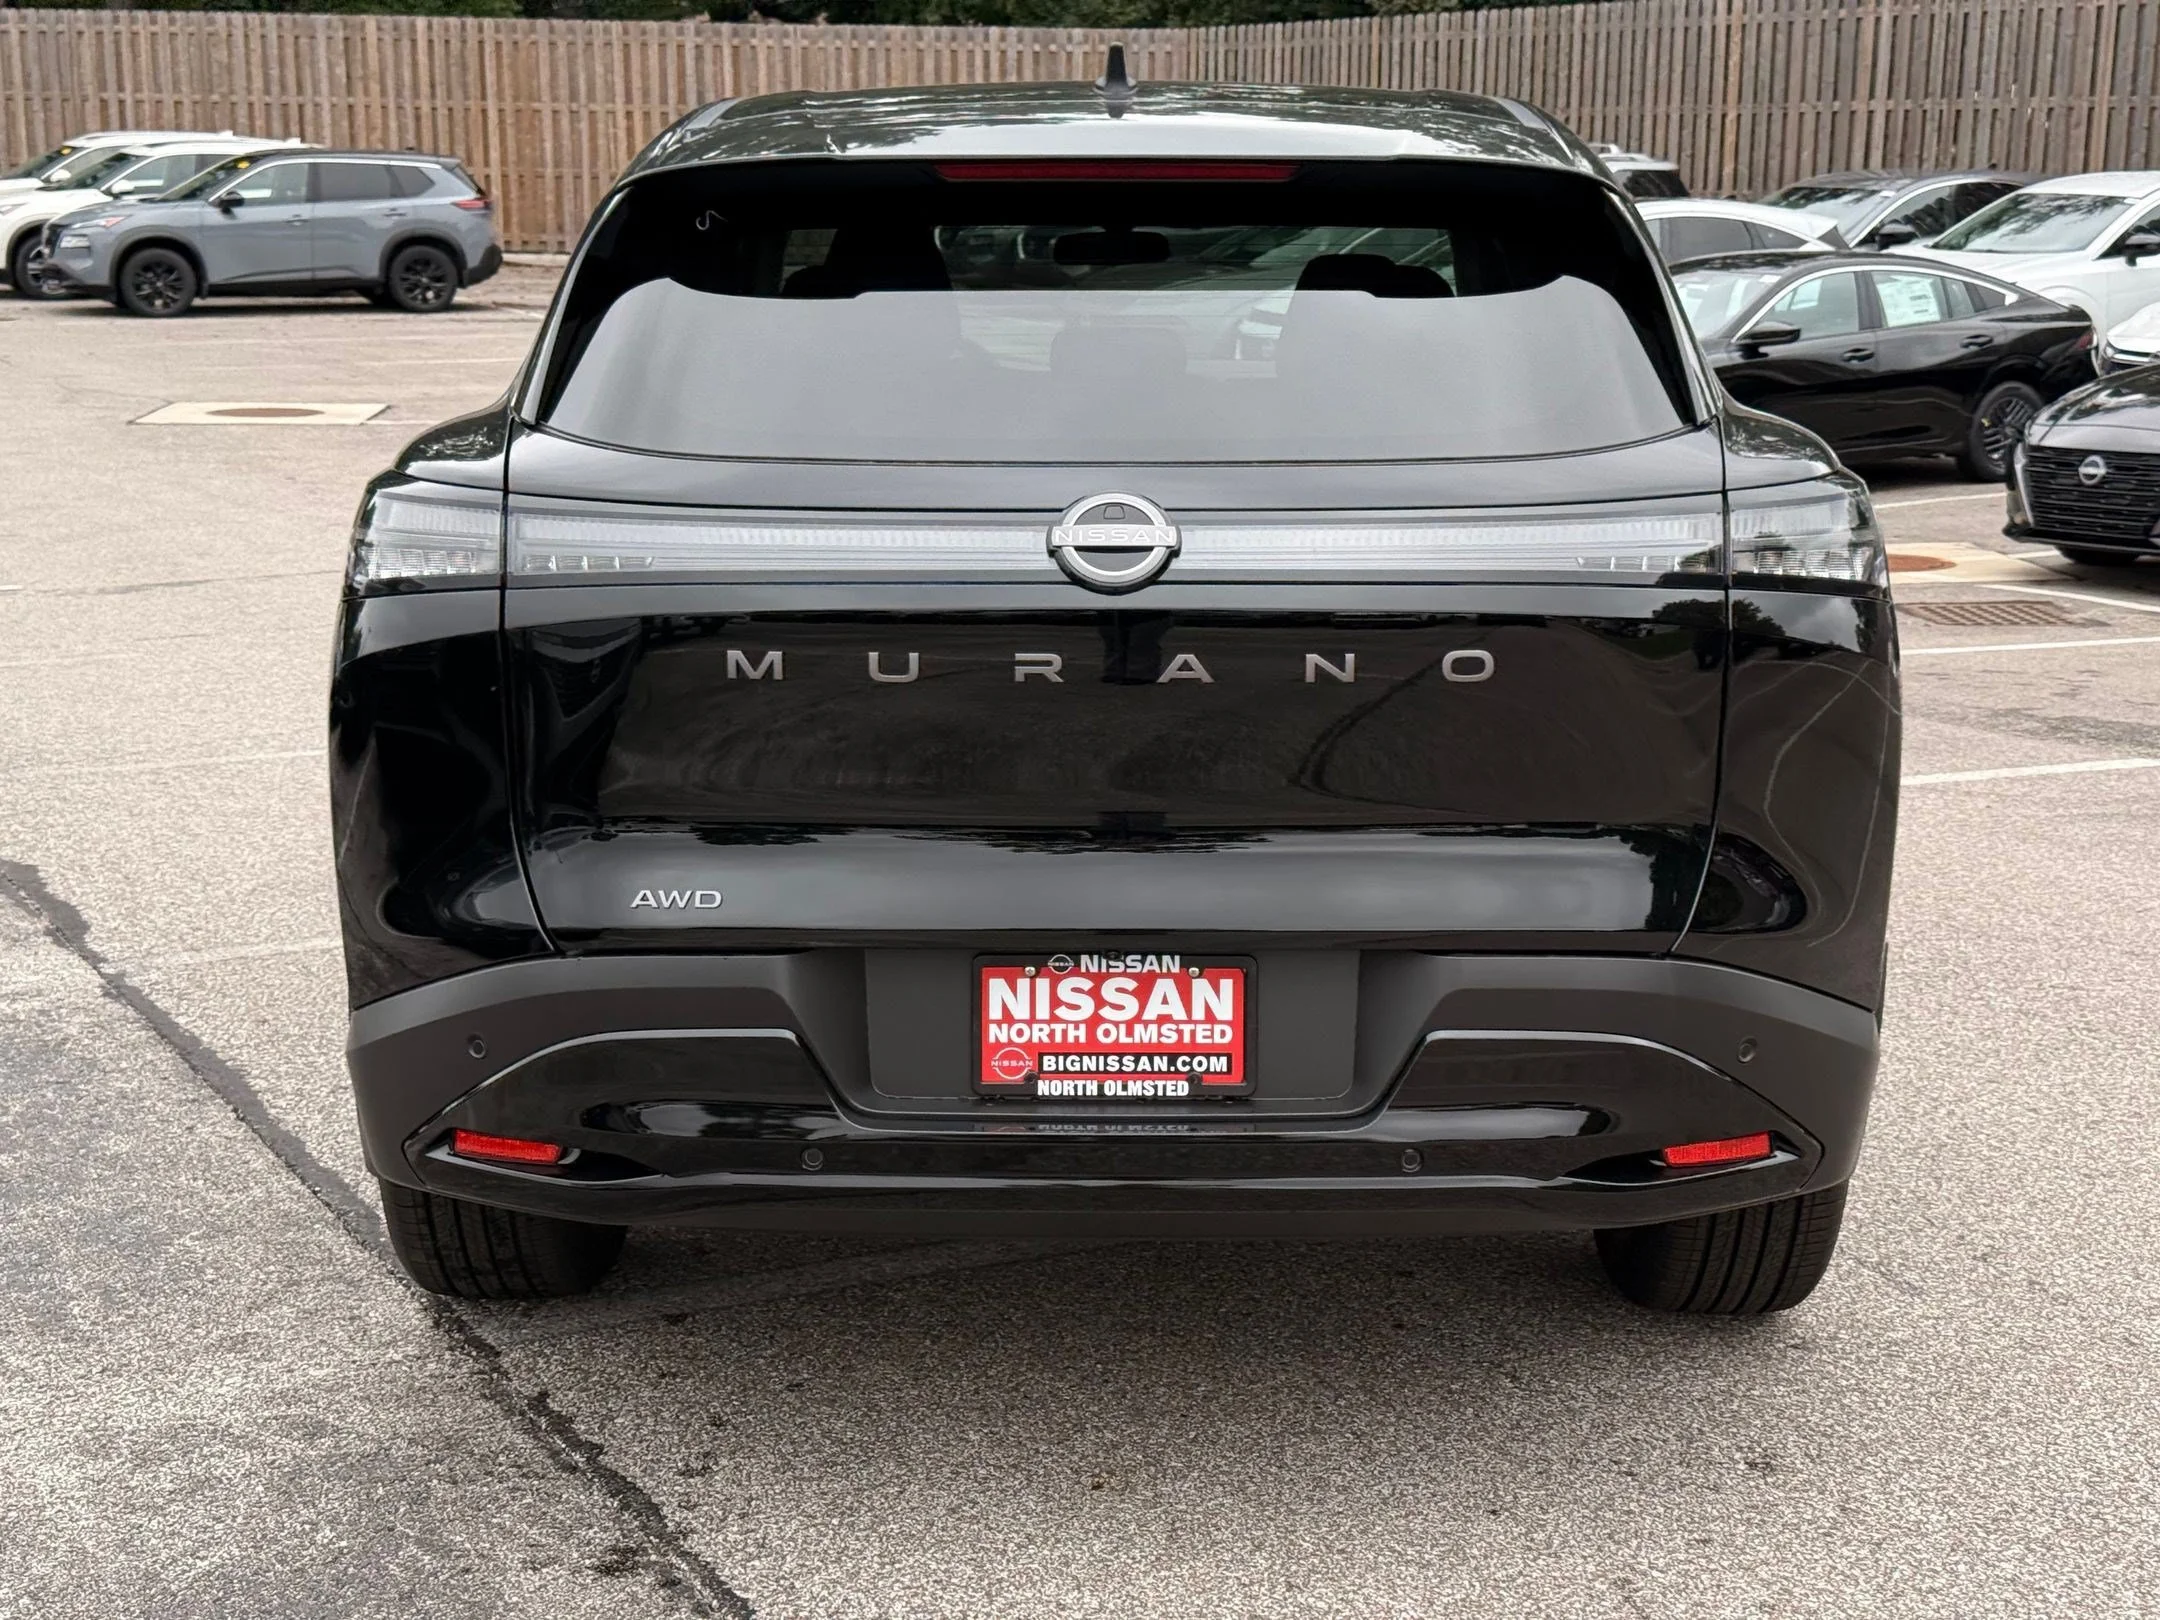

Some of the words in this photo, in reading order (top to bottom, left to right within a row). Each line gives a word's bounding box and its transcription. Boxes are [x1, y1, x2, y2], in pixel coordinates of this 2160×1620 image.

[1054, 528, 1174, 544] NISSAN
[726, 649, 1496, 683] MURANO
[629, 889, 723, 909] AWD
[1080, 954, 1181, 974] NISSAN
[988, 976, 1234, 1022] NISSAN
[988, 1022, 1088, 1044] NORTH
[1096, 1022, 1234, 1044] OLMSTED
[990, 1060, 1034, 1068] NISSAN
[1042, 1055, 1229, 1073] BIGNISSAN.COM
[1037, 1079, 1098, 1097] NORTH
[1104, 1079, 1190, 1097] OLMSTED
